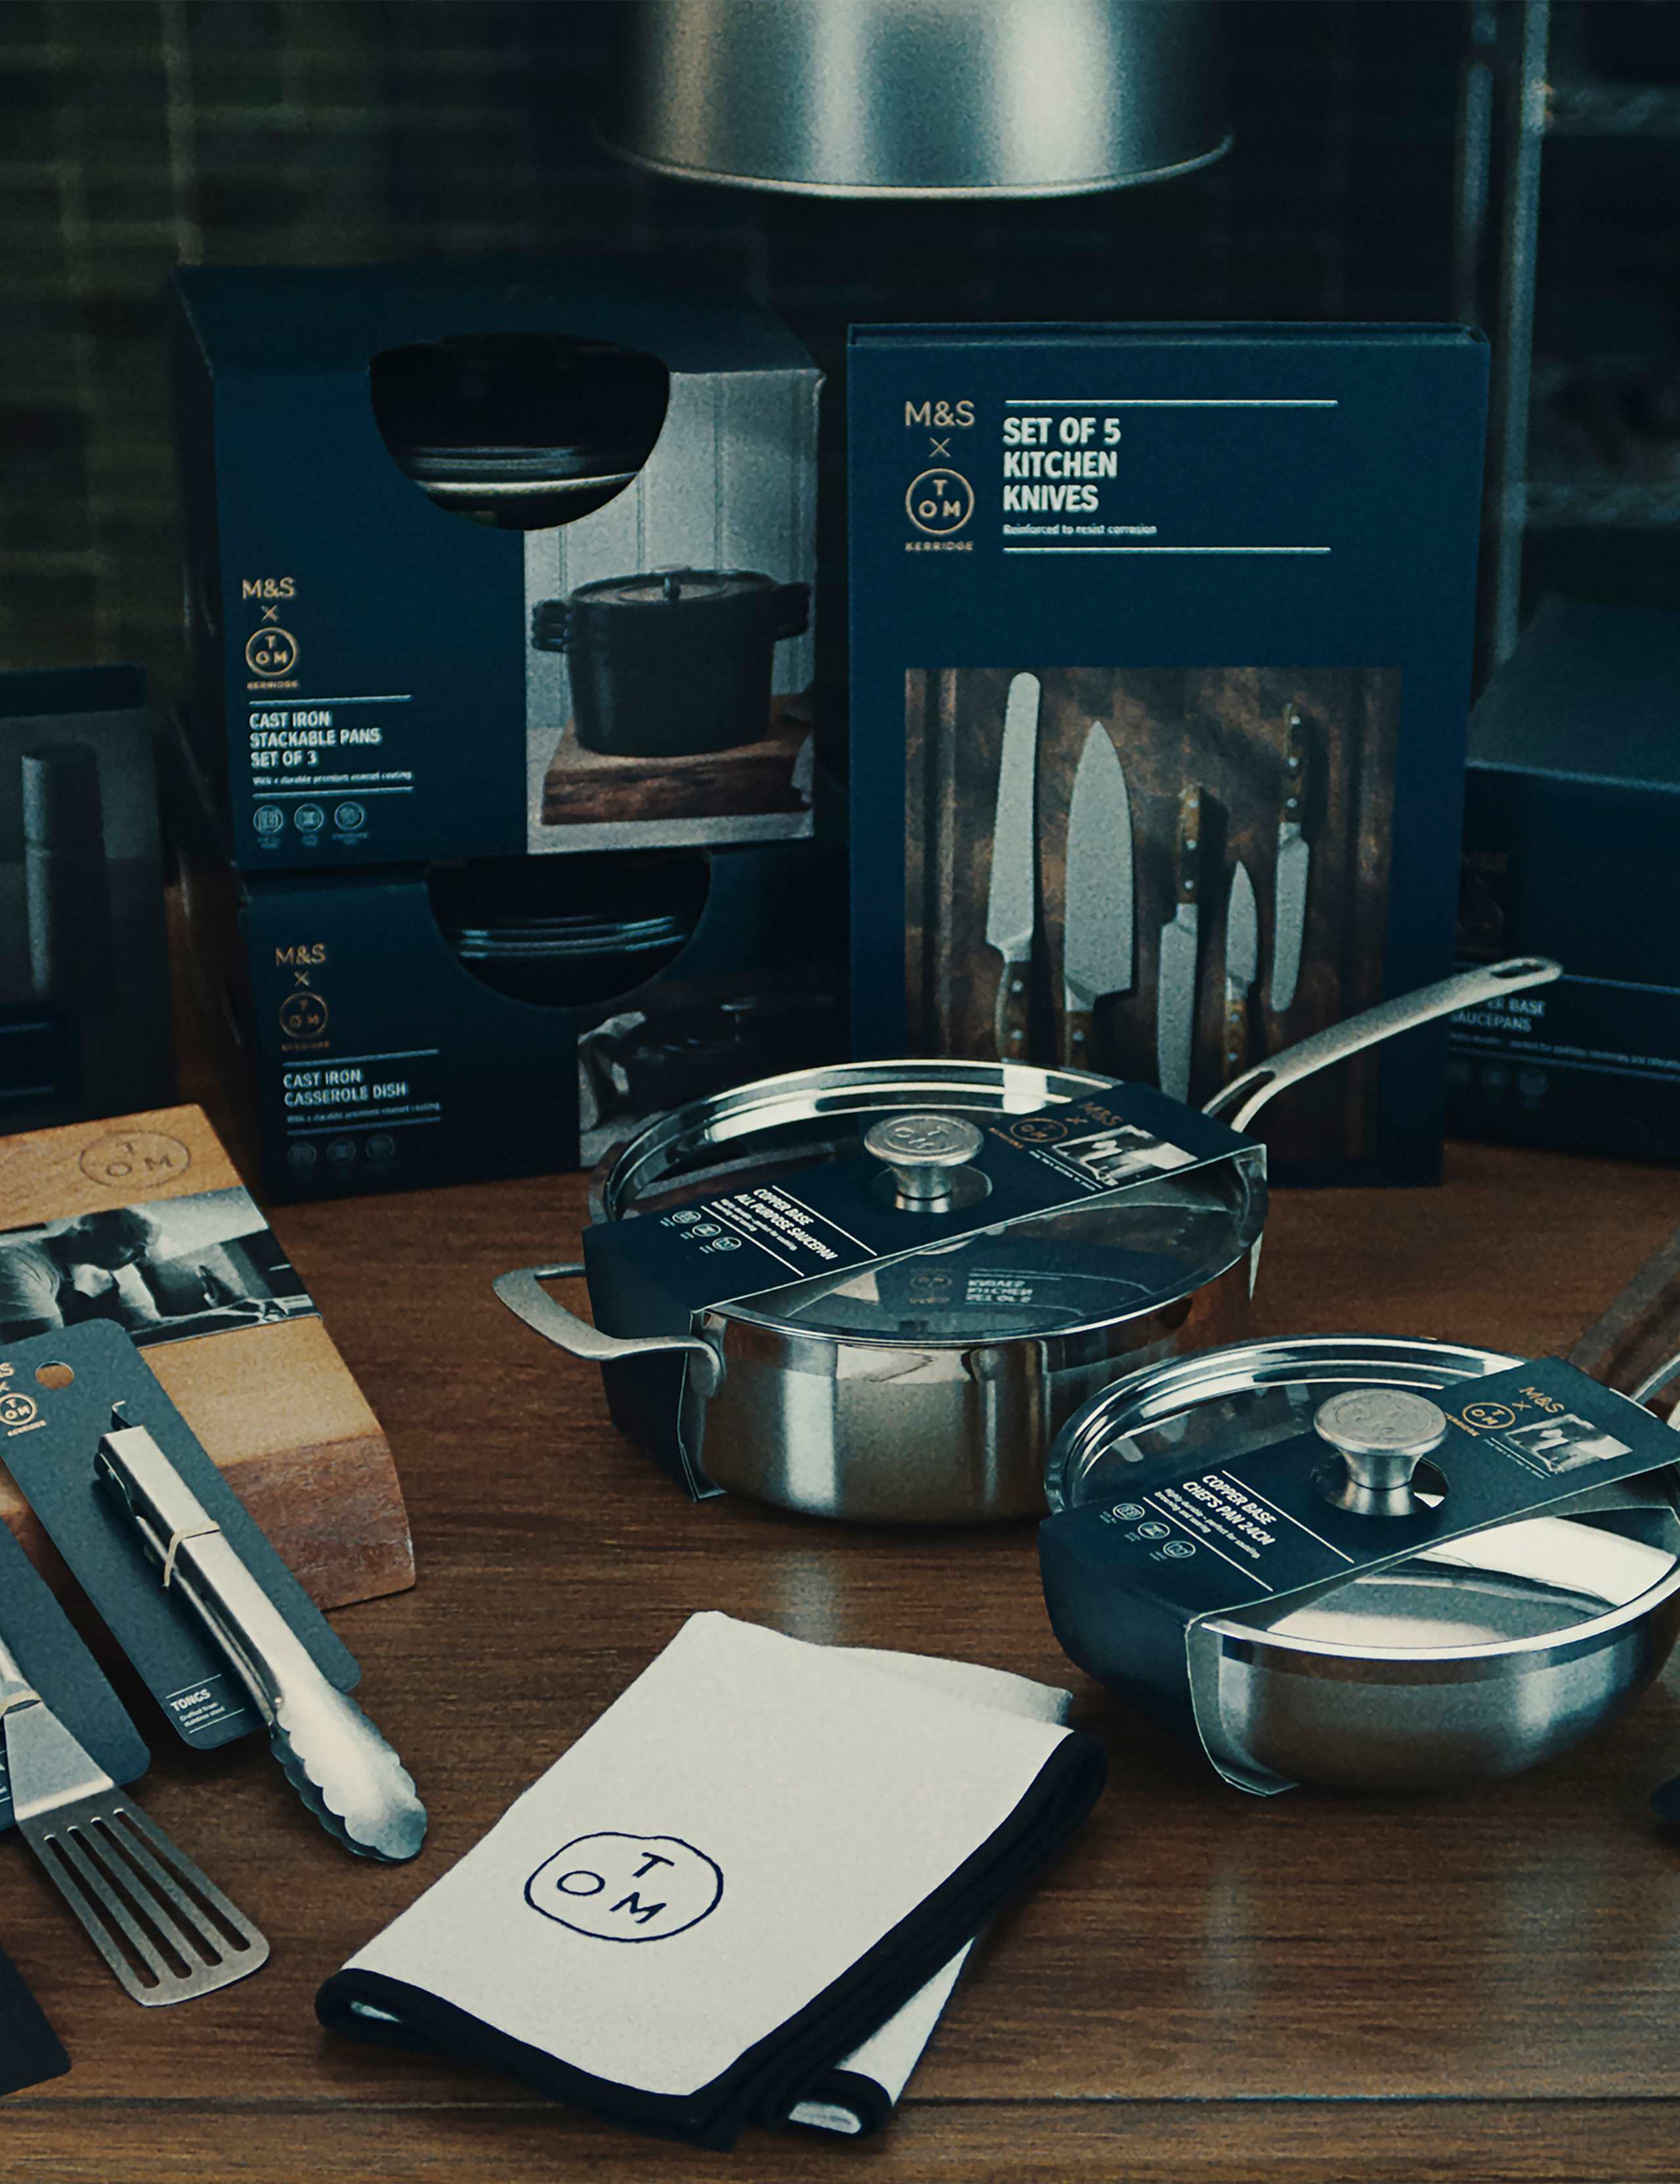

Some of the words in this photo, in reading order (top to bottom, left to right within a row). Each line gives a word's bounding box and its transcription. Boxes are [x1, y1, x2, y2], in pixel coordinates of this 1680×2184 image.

[905, 400, 975, 429] M&S
[1002, 417, 1053, 446] SET
[1059, 417, 1097, 446] OF
[1103, 418, 1122, 446] 5
[1003, 451, 1118, 480] KITCHEN
[1003, 484, 1099, 513] KNIVES
[1003, 523, 1060, 535] Reinforced
[1061, 524, 1074, 535] to
[1075, 523, 1105, 535] resist
[1106, 523, 1157, 535] corrosion
[905, 541, 974, 552] KERRIDGE
[242, 577, 297, 599] M&S
[249, 712, 289, 730] CAST
[292, 710, 333, 728] IRON
[250, 730, 337, 749] STACKABLE
[339, 727, 384, 746] PANS
[251, 750, 280, 769] SET
[282, 750, 303, 768] OF
[306, 750, 320, 767] 3
[275, 942, 327, 967] M&S
[283, 1070, 323, 1090] CAST
[325, 1067, 364, 1086] IRON
[284, 1085, 370, 1108] CASSEROLE
[372, 1081, 410, 1101] DISH
[753, 1188, 791, 1213] COPPER
[784, 1208, 814, 1226] BASE
[733, 1194, 756, 1207] ALL
[749, 1203, 795, 1231] PURPOSE
[787, 1227, 839, 1260] SAUCEPAN
[1519, 1386, 1566, 1414] M&S
[1202, 1474, 1249, 1506] COPPER
[1242, 1502, 1277, 1526] BASE
[1215, 1505, 1246, 1524] PAN
[1238, 1521, 1276, 1546] 24CM
[170, 1689, 211, 1712] TONGS
